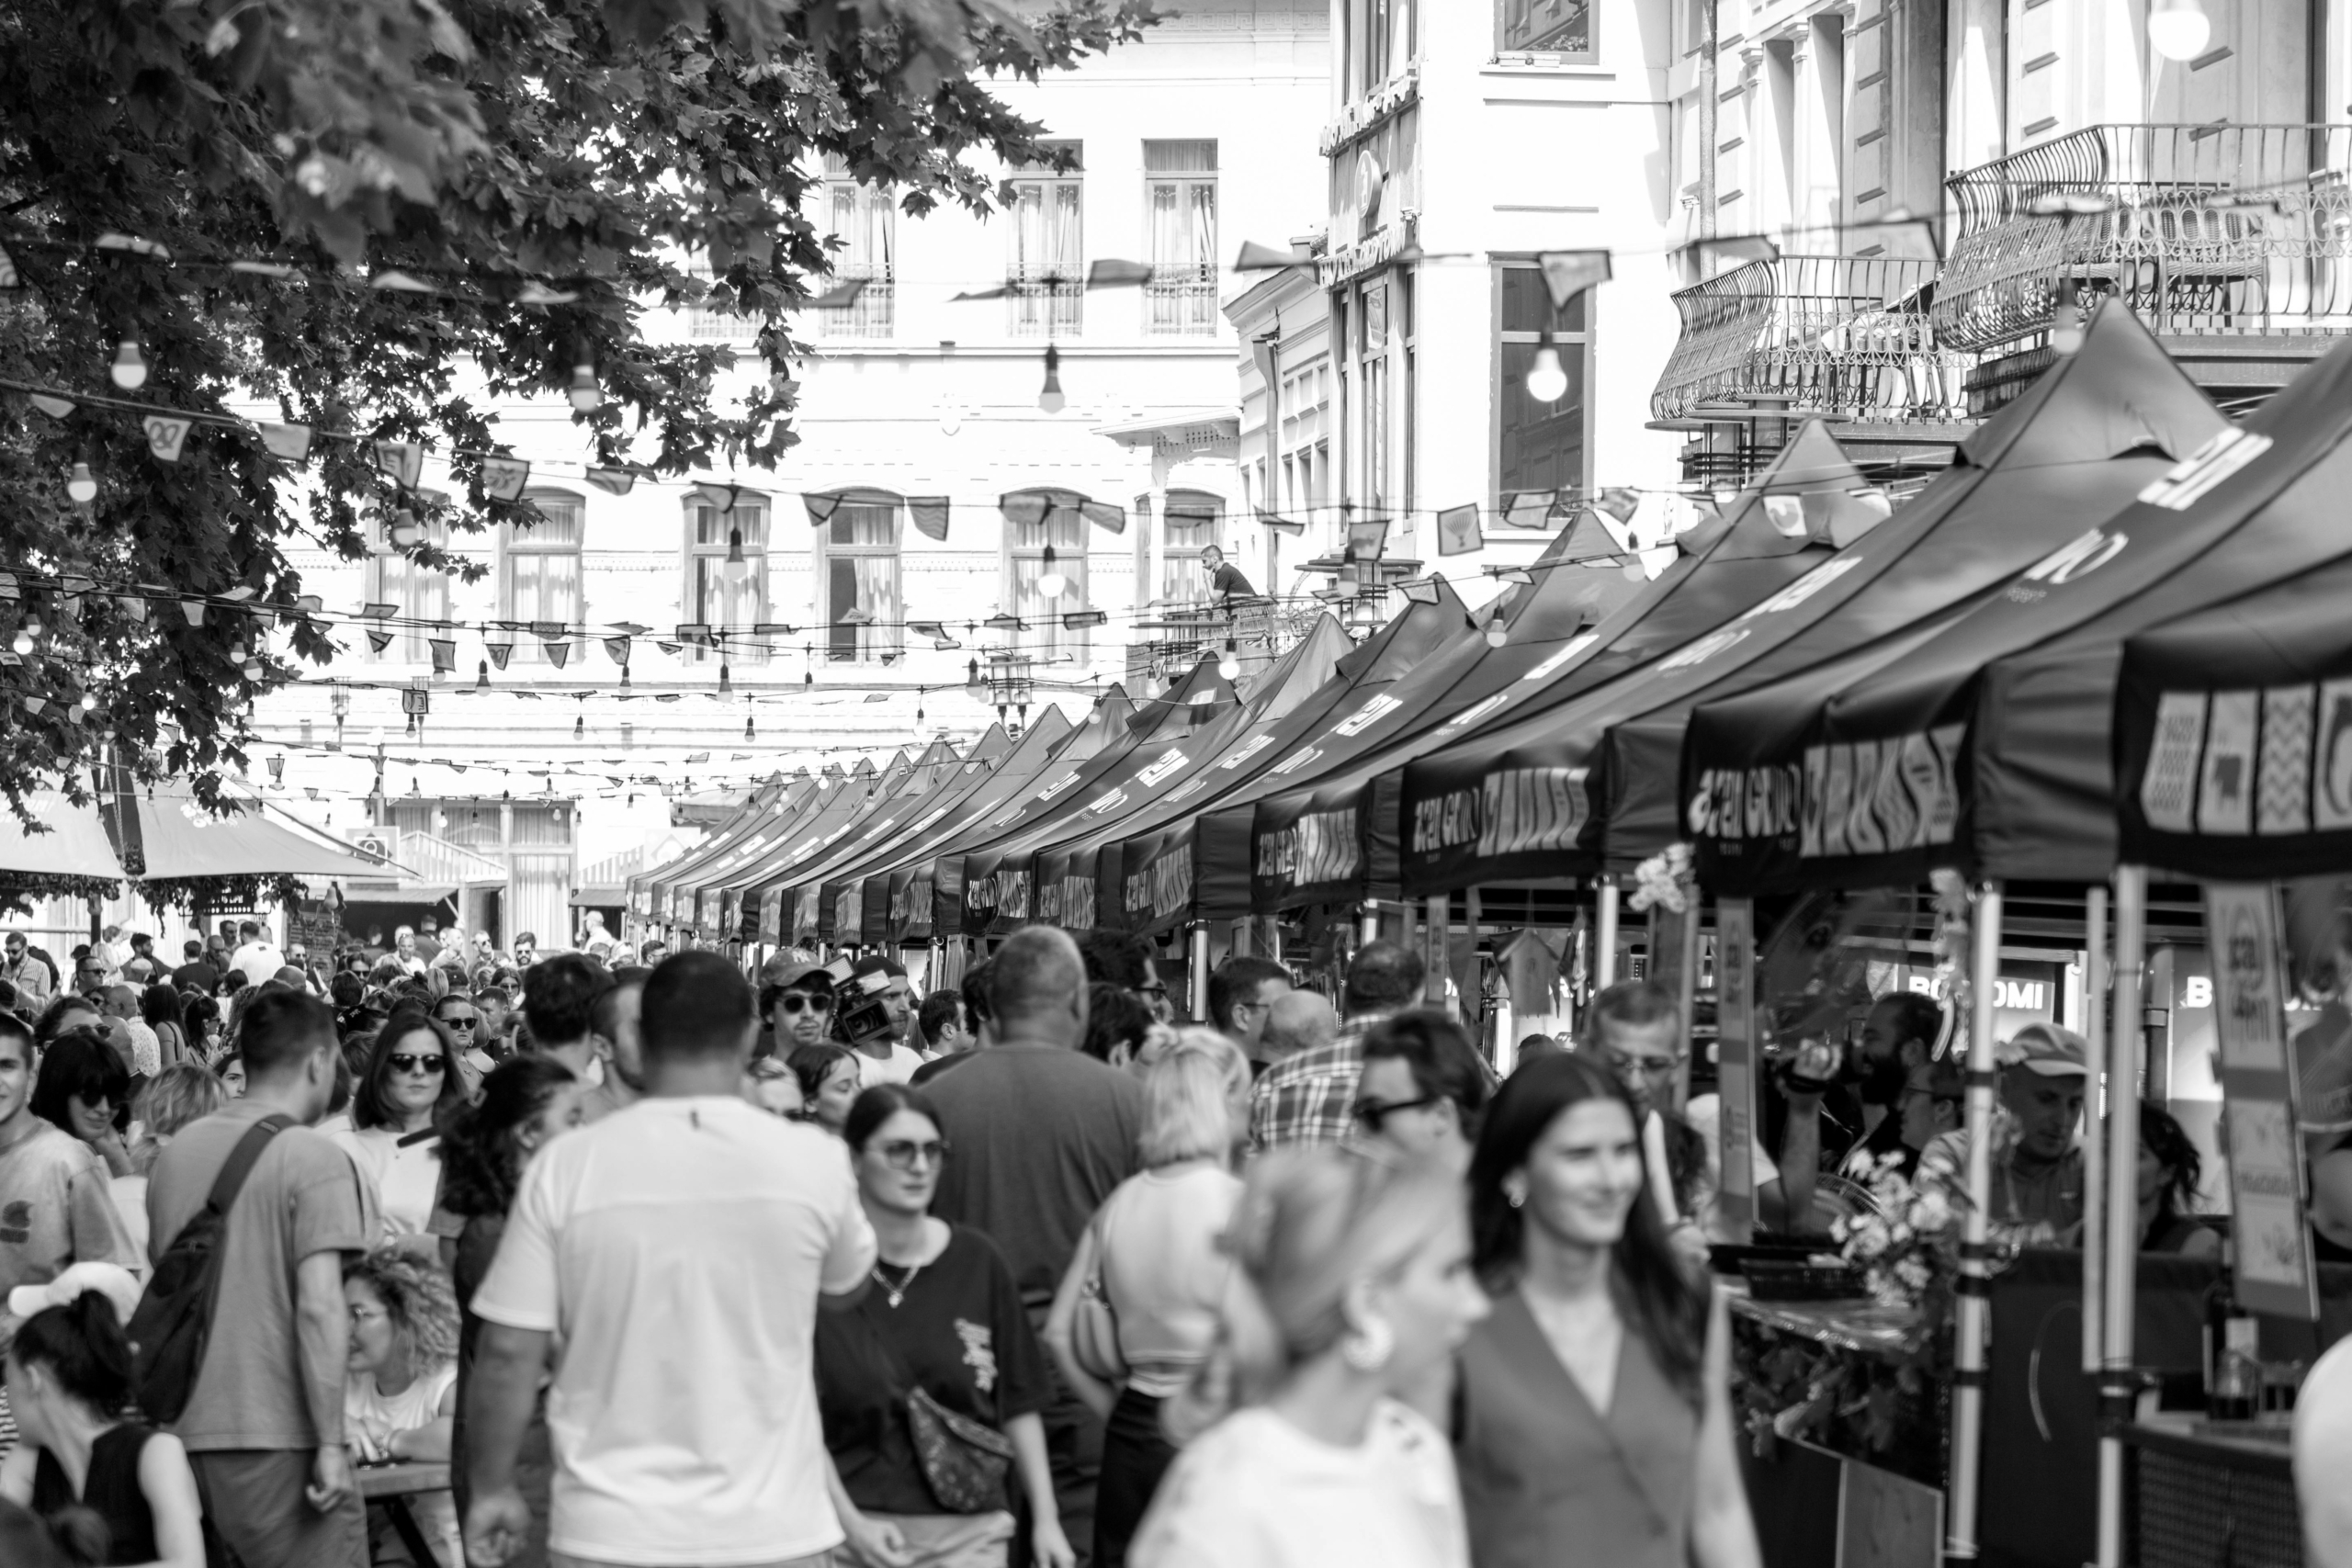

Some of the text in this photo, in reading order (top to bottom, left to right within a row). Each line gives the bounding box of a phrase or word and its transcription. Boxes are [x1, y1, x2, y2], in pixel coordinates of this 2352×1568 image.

[1319, 222, 1407, 290] HOTEL OLD TOWN
